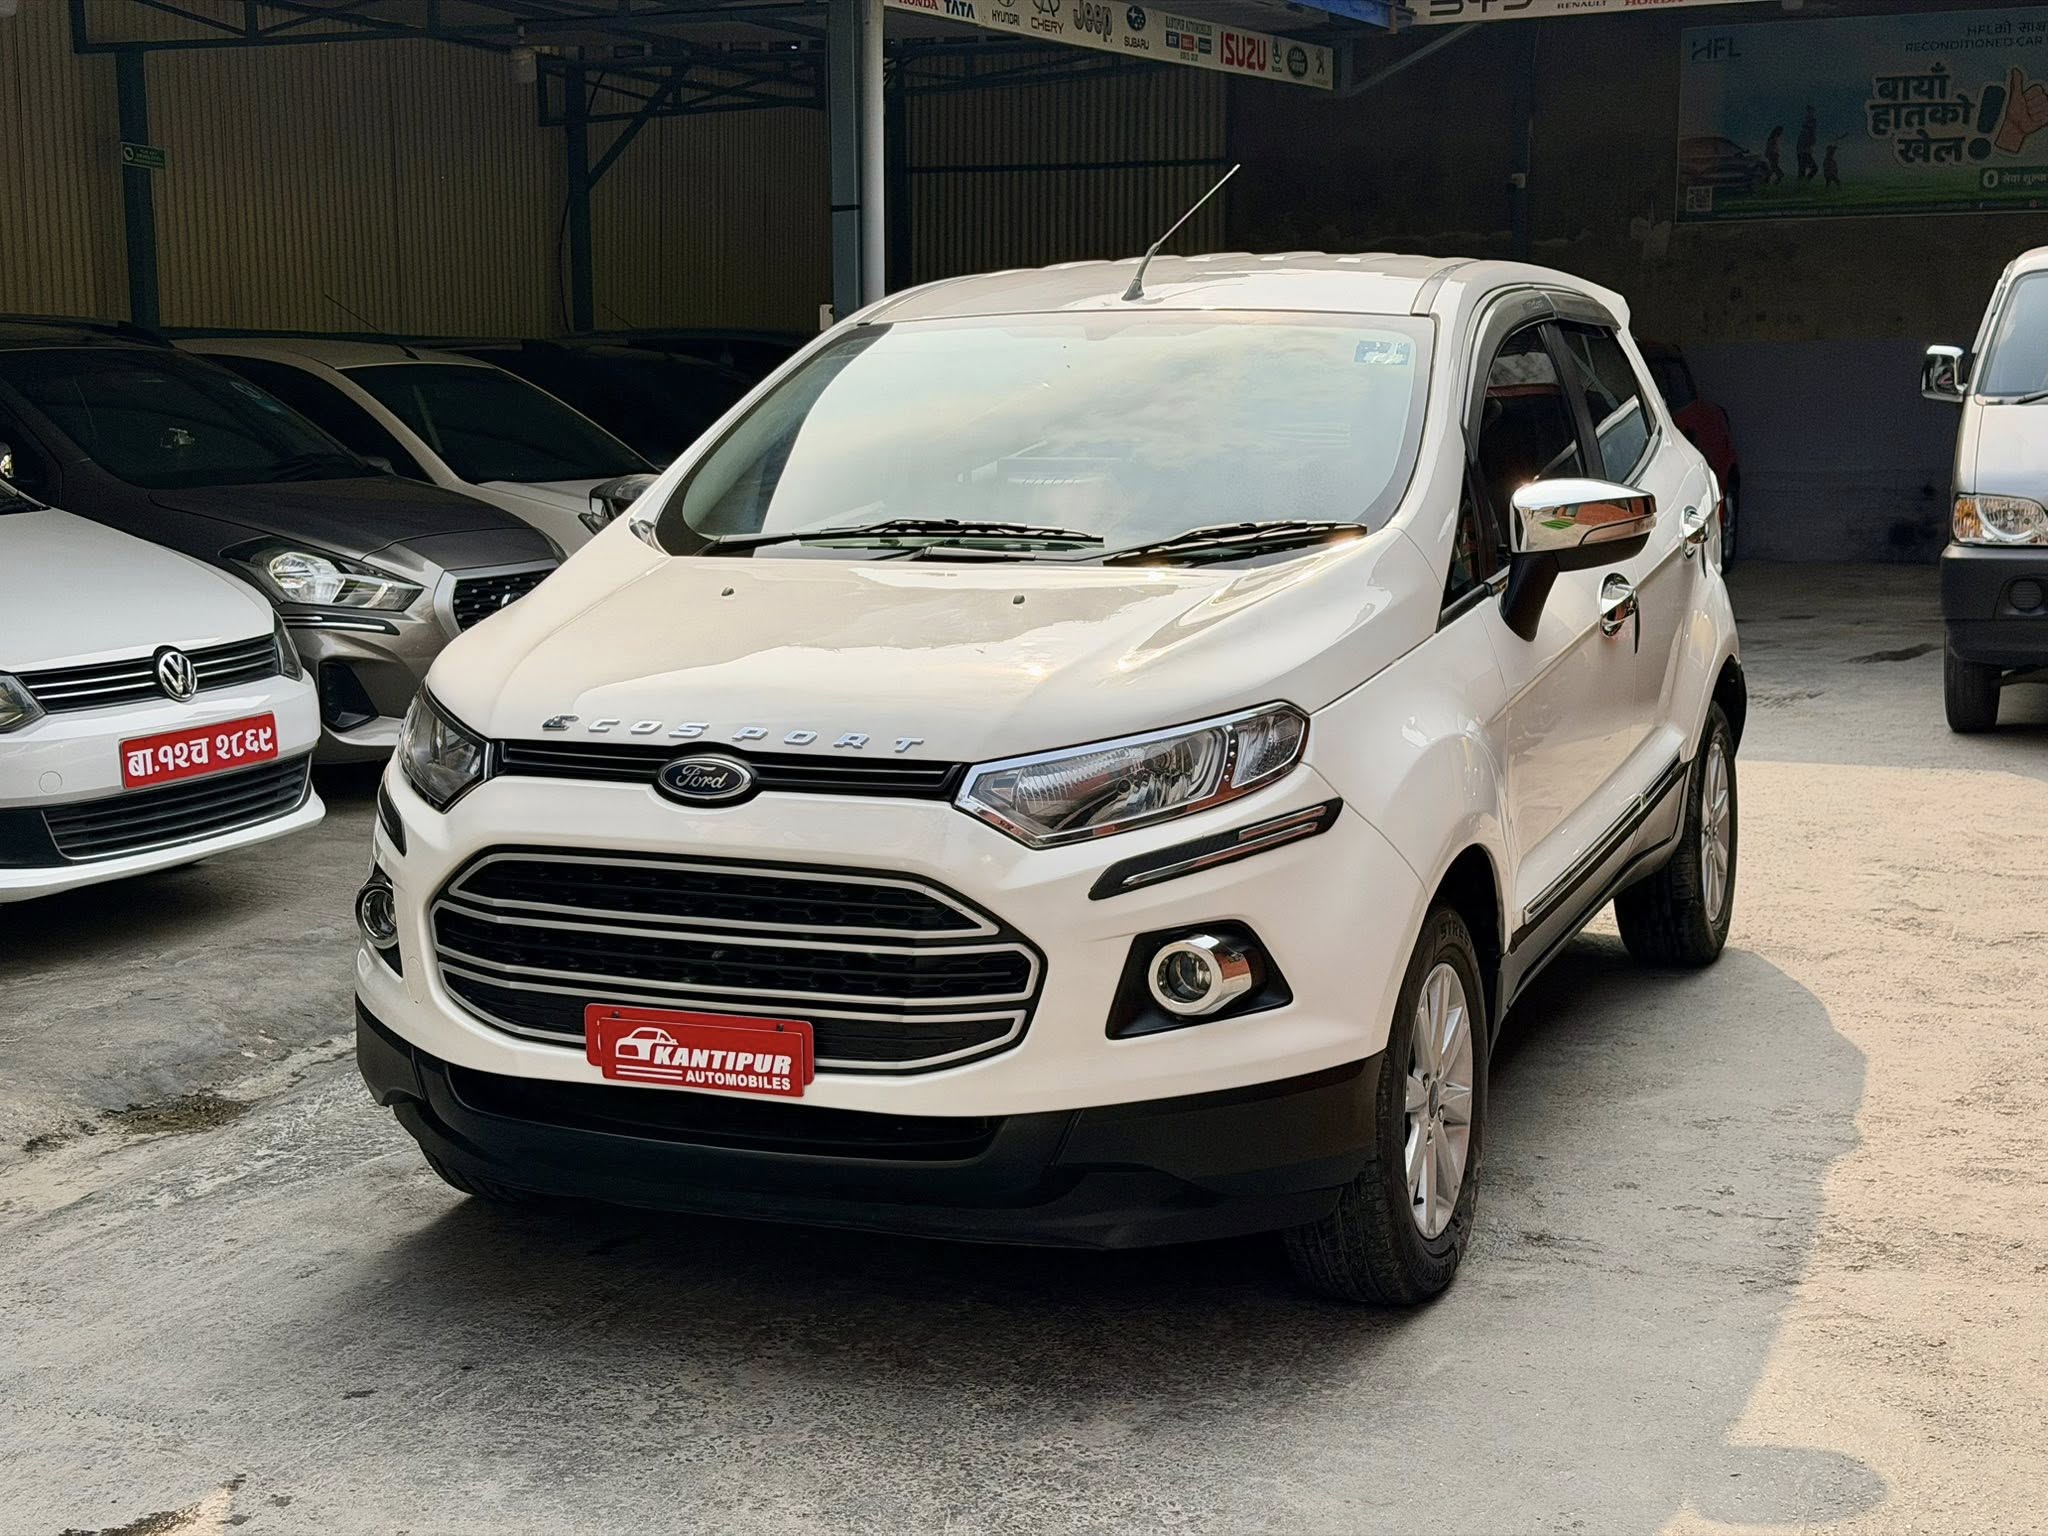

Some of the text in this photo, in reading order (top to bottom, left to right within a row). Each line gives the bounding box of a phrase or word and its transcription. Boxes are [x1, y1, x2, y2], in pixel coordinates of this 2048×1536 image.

[943, 0, 975, 19] TATA
[1557, 1, 1606, 9] RENAULT
[992, 9, 1020, 26] HYUNDAI
[1031, 16, 1064, 34] CHERY
[1073, 1, 1112, 42] Jeep
[1124, 36, 1149, 50] SUBARU
[1220, 31, 1266, 72] ISUZU
[1692, 37, 1742, 60] HFL
[1905, 36, 2043, 52] RECONDITIONED CAR
[1870, 94, 1975, 135] हातको
[676, 764, 729, 790] Ford
[653, 1045, 792, 1075] KANTIPUR
[685, 1068, 791, 1091] AUTOMOBILES
